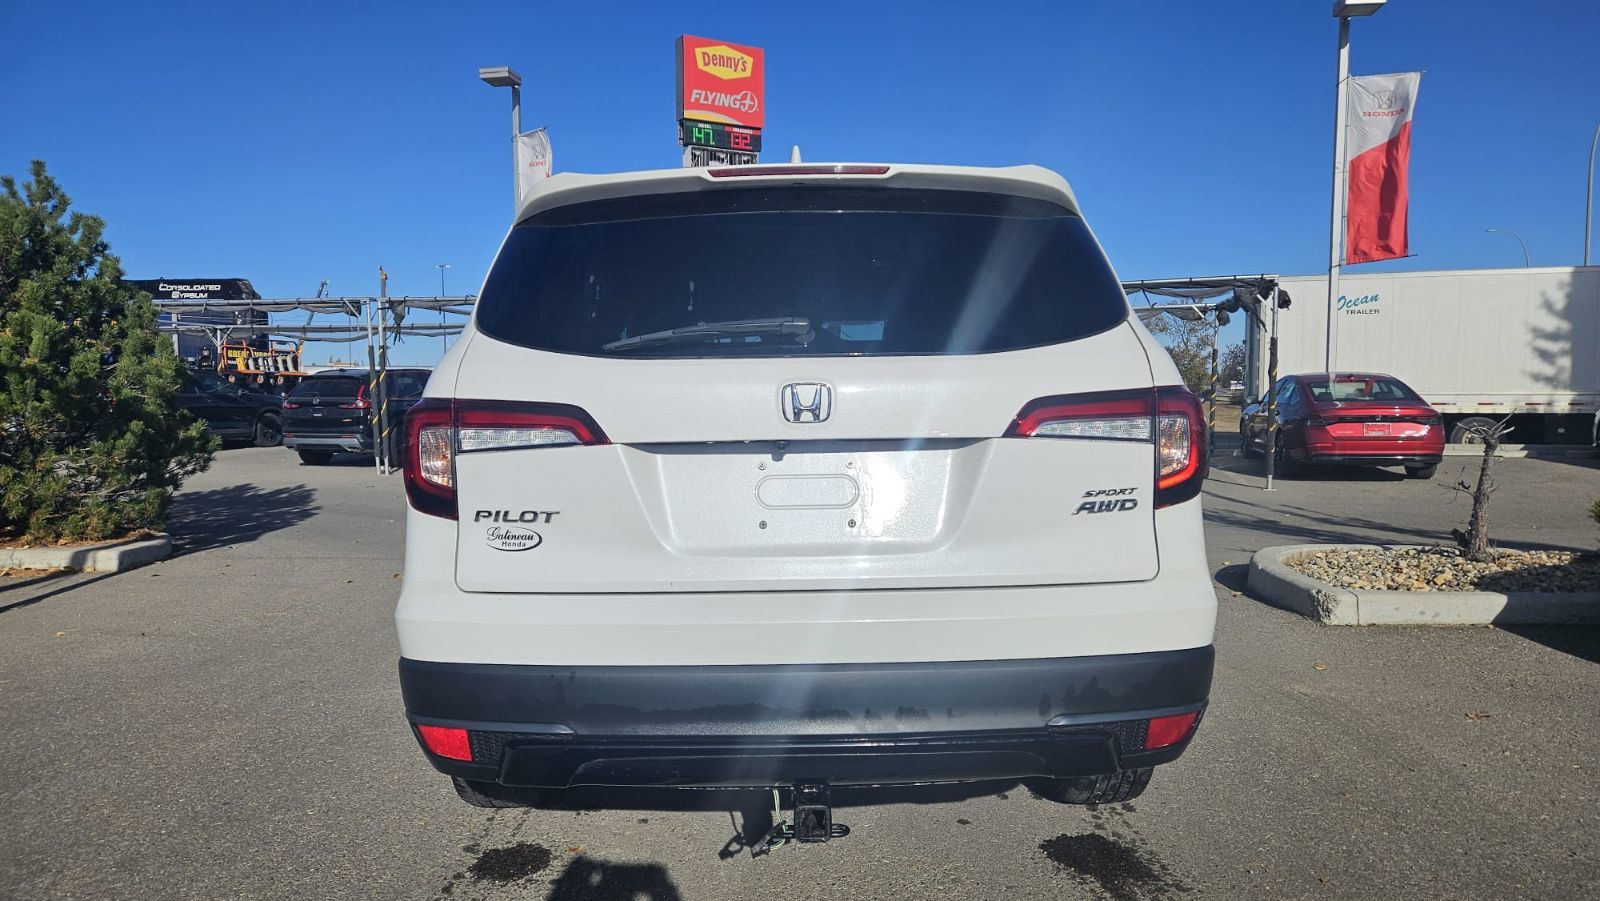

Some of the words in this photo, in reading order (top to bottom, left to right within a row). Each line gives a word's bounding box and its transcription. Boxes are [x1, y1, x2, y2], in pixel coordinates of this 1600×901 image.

[701, 51, 748, 72] Denny's
[690, 89, 740, 108] FLYING
[1362, 108, 1405, 117] HONDA
[1337, 293, 1380, 311] Ocean
[1081, 487, 1138, 498] SPORT
[1071, 498, 1138, 515] AWD
[474, 510, 561, 523] PILOT
